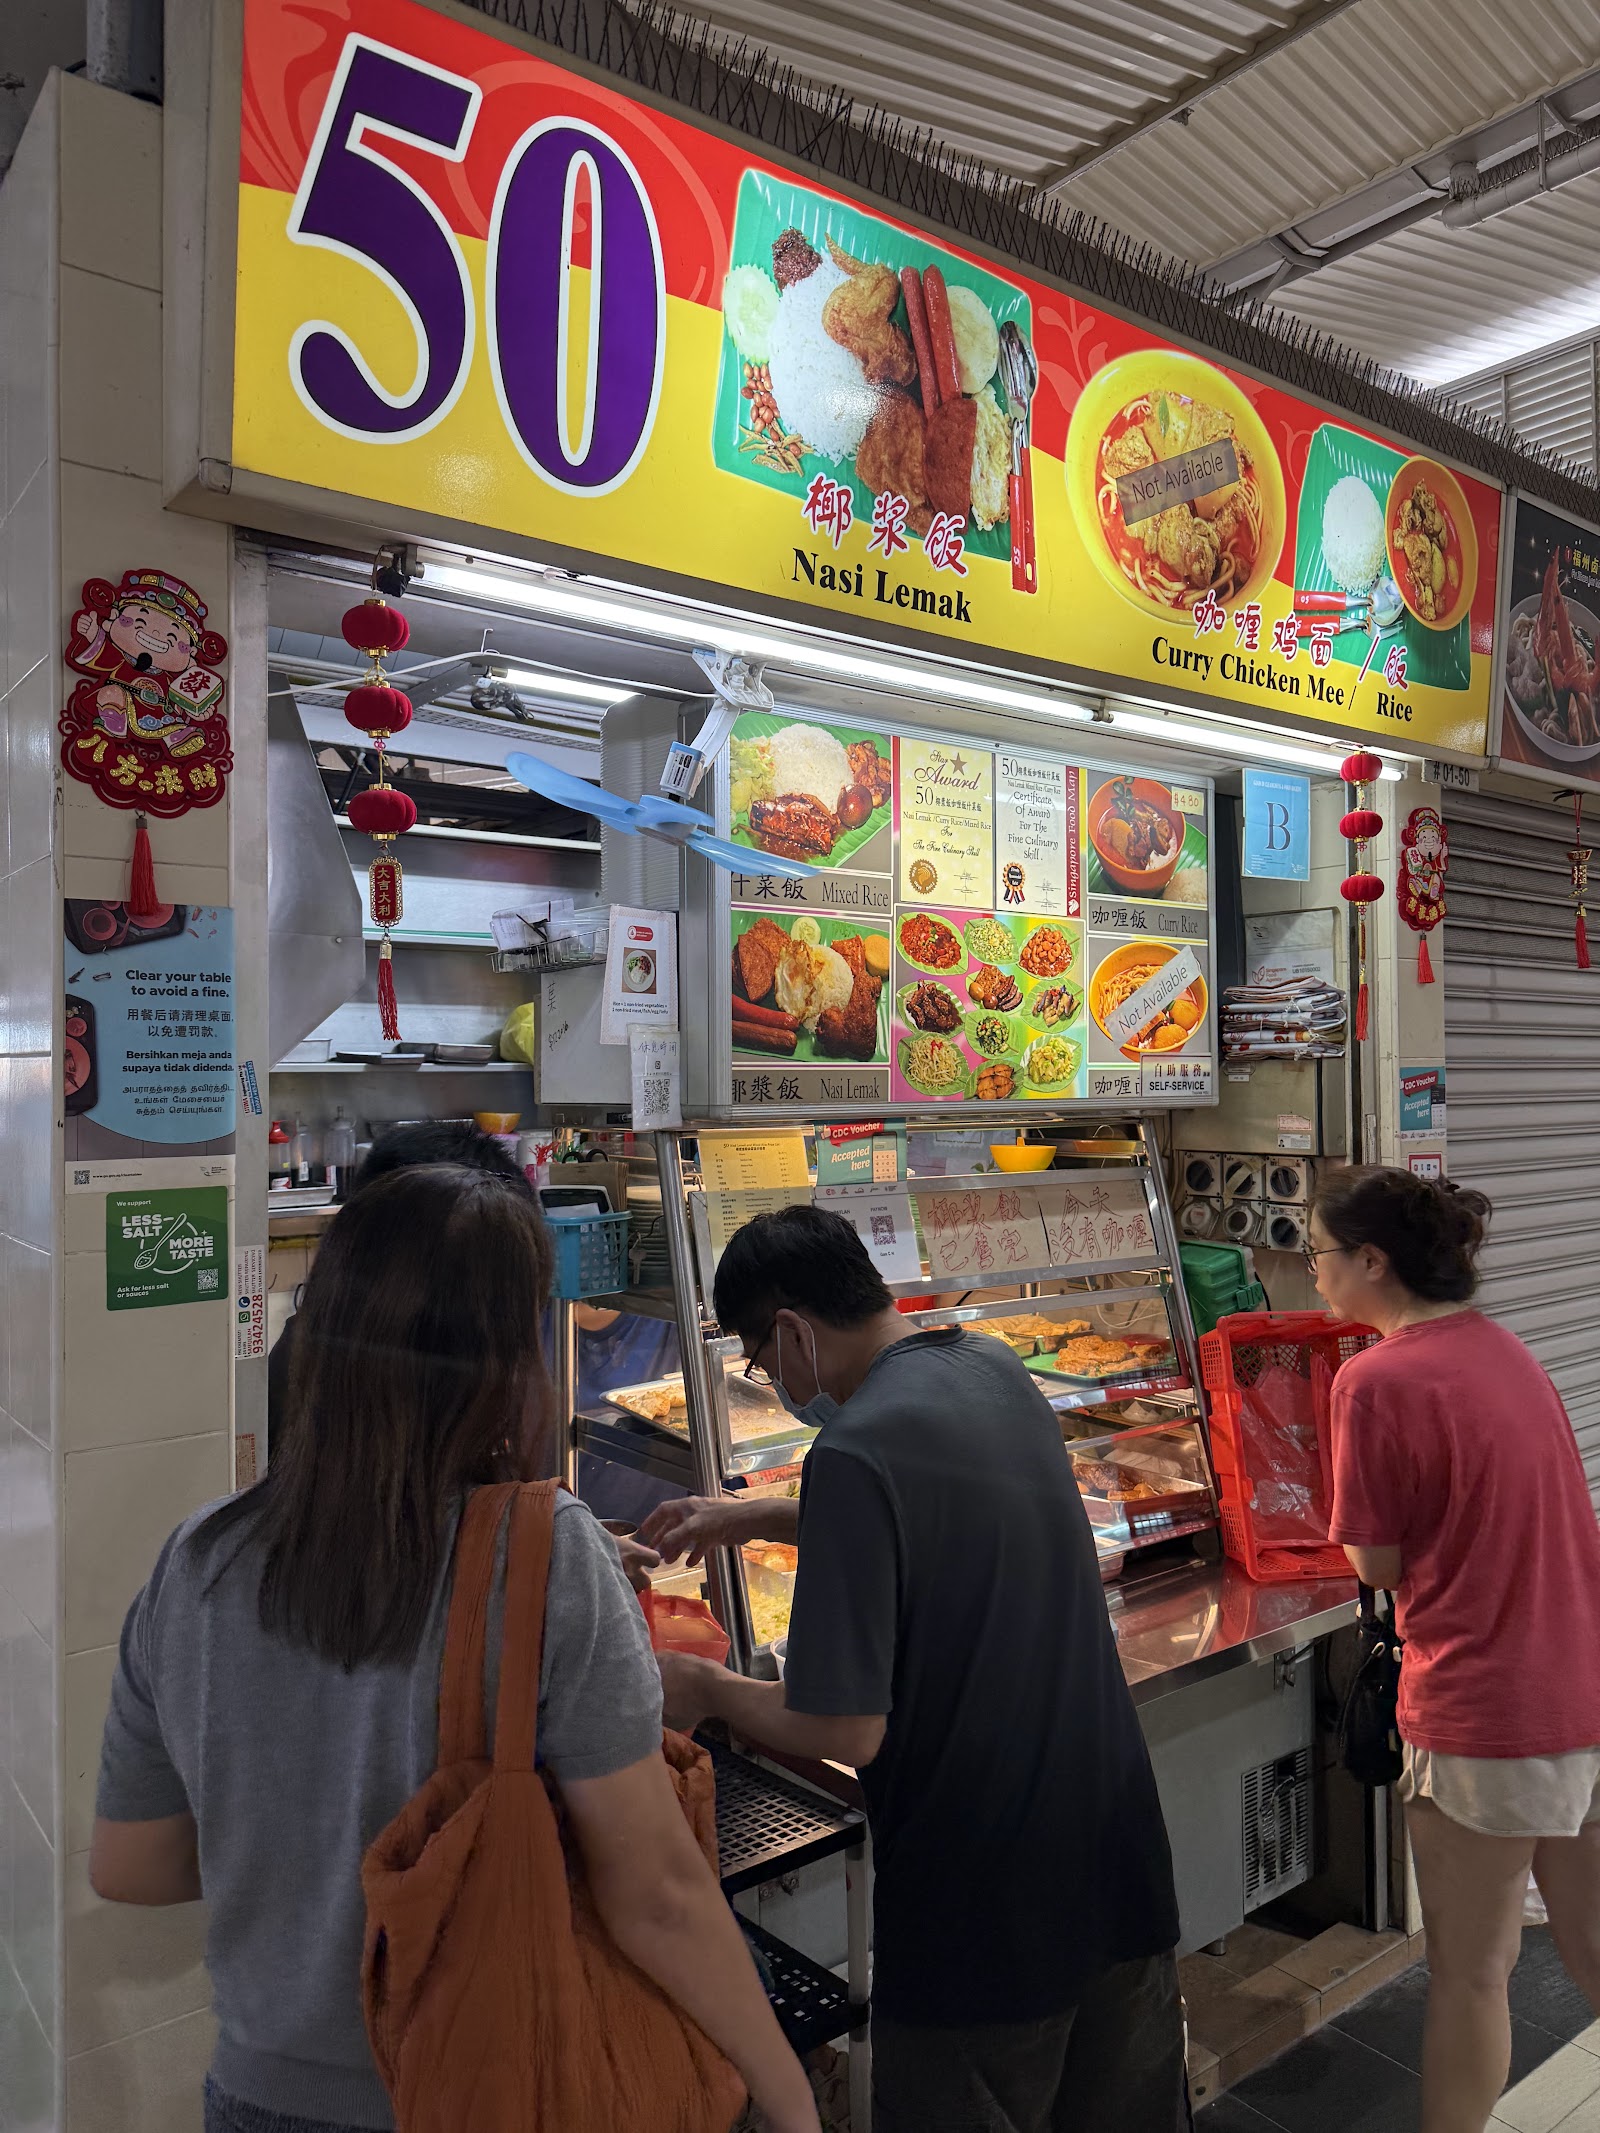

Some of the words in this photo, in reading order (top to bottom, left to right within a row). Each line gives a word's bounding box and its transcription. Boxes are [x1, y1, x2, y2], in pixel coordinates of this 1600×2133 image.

[287, 32, 666, 497] 50
[1132, 478, 1162, 504] Not
[1165, 453, 1224, 489] Available
[1572, 549, 1600, 575] 福州卤
[792, 548, 863, 597] Nasi
[874, 570, 972, 623] Lemak
[1153, 636, 1214, 680] Curry
[1221, 653, 1300, 696] Chicken
[1376, 692, 1412, 721] Rice
[914, 763, 981, 790] Award
[916, 786, 934, 805] 50
[1068, 771, 1077, 802] Map
[1014, 791, 1052, 805] Certificate
[1016, 804, 1025, 818] Of
[1028, 808, 1050, 818] Award
[1067, 805, 1076, 833] Food
[1019, 821, 1031, 830] For
[1033, 820, 1047, 833] The
[1266, 802, 1290, 850] B
[1008, 833, 1023, 843] Fine
[1025, 835, 1058, 850] Culinary
[1068, 838, 1079, 898] Singapore
[376, 867, 392, 916] 大吉大利
[822, 882, 858, 904] Mixed
[862, 884, 889, 907] Rice
[1158, 913, 1179, 936] Curry
[1182, 915, 1198, 934] Rice
[126, 970, 162, 980] Clear
[165, 973, 196, 983] your
[200, 972, 231, 982] table
[131, 986, 146, 995] to
[150, 986, 188, 996] avoid
[202, 986, 229, 997] fine.
[1118, 1008, 1142, 1034] Not
[1143, 966, 1188, 1015] Available
[126, 1050, 178, 1059] Bersihkan
[182, 1050, 206, 1060] meja
[209, 1051, 232, 1059] anda
[122, 1065, 161, 1074] supaya
[164, 1063, 190, 1072] tidak
[193, 1064, 234, 1072] didenda.
[821, 1078, 843, 1099] Nasi
[846, 1077, 880, 1098] Lemak
[1094, 1076, 1140, 1096] 咖喱
[1150, 1081, 1205, 1090] SELF-SERVICE
[1405, 1080, 1416, 1090] CDC
[1416, 1075, 1436, 1088] Voucher
[1404, 1097, 1429, 1112] Accepted
[1417, 1108, 1430, 1118] here
[832, 1128, 849, 1138] CDC
[850, 1122, 880, 1135] Voucher
[832, 1146, 870, 1163] Accepted
[851, 1159, 870, 1171] here
[1060, 1186, 1124, 1226] 今天
[122, 1214, 162, 1227] LESS
[122, 1226, 162, 1238] SALT
[170, 1236, 213, 1249] MORE
[940, 1229, 1030, 1271] 已售完
[170, 1247, 213, 1260] TASTE
[252, 1295, 263, 1353] 93424528
